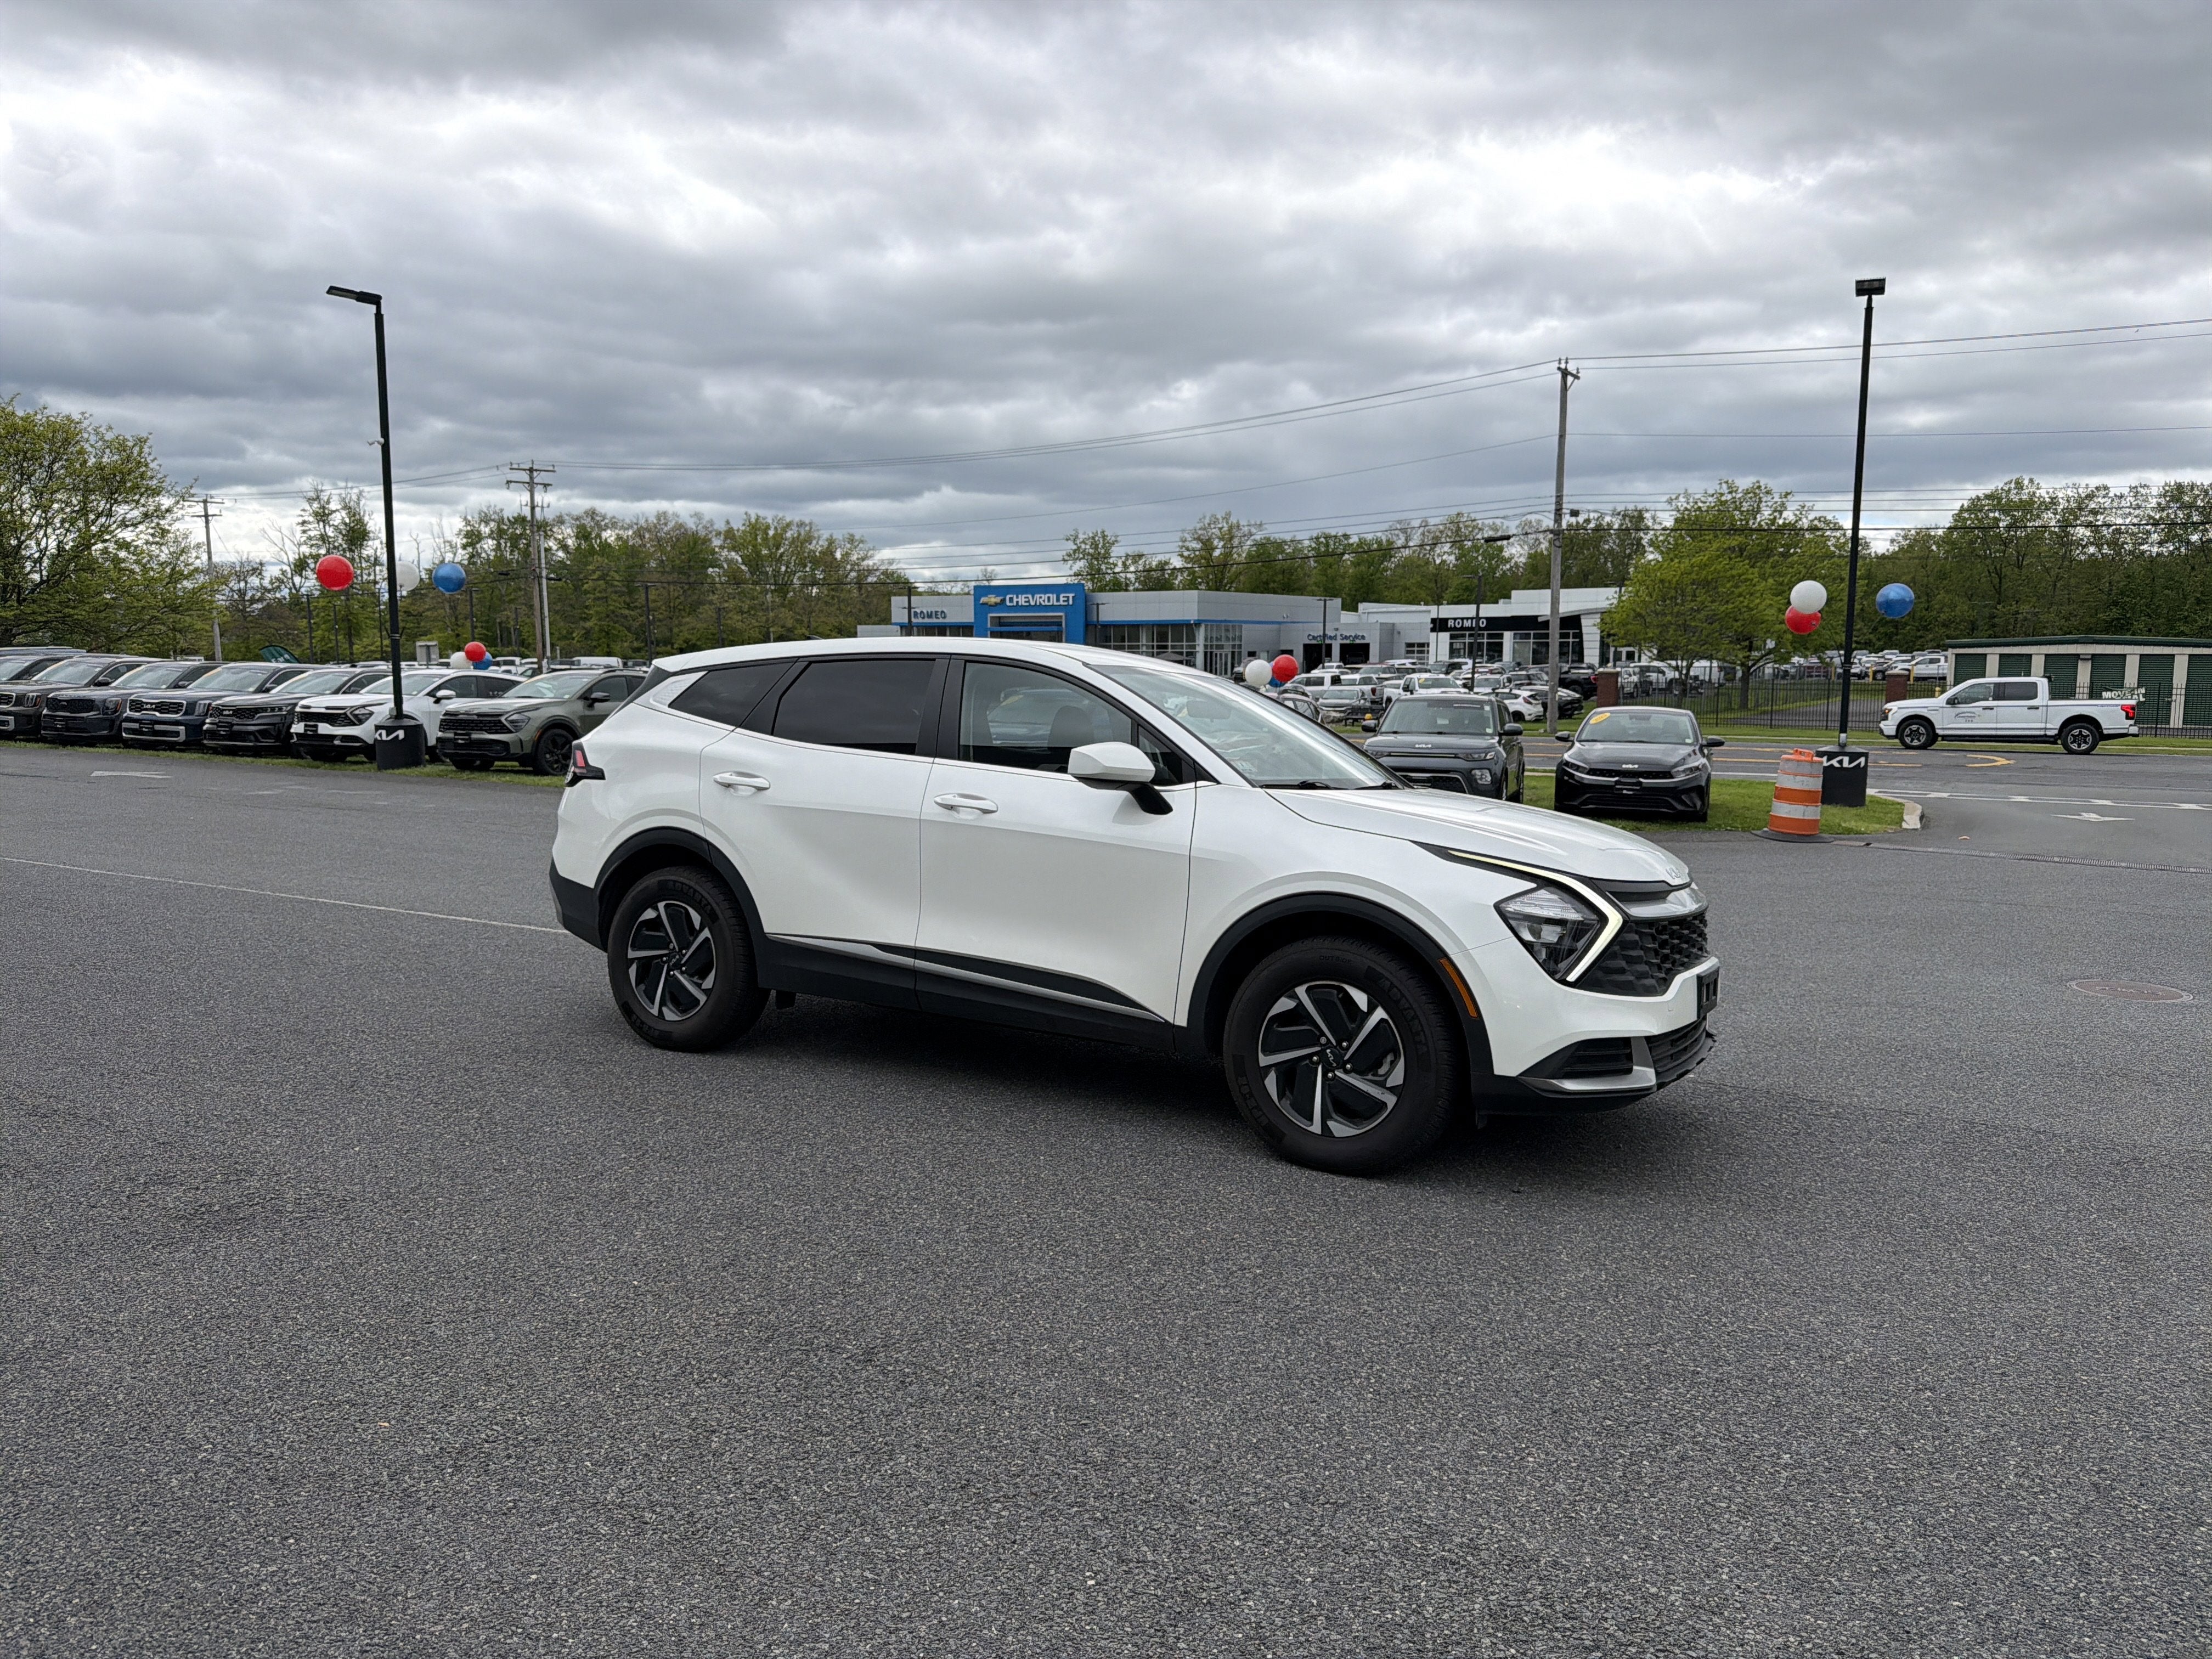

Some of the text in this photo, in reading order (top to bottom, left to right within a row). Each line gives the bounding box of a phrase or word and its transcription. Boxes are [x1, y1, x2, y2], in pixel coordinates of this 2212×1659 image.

[1006, 594, 1075, 606] CHEVROLET
[913, 610, 947, 619] ROMEO
[1340, 633, 1366, 641] Service
[2102, 687, 2146, 699] MOVE-IN
[1823, 755, 1865, 768] KIA
